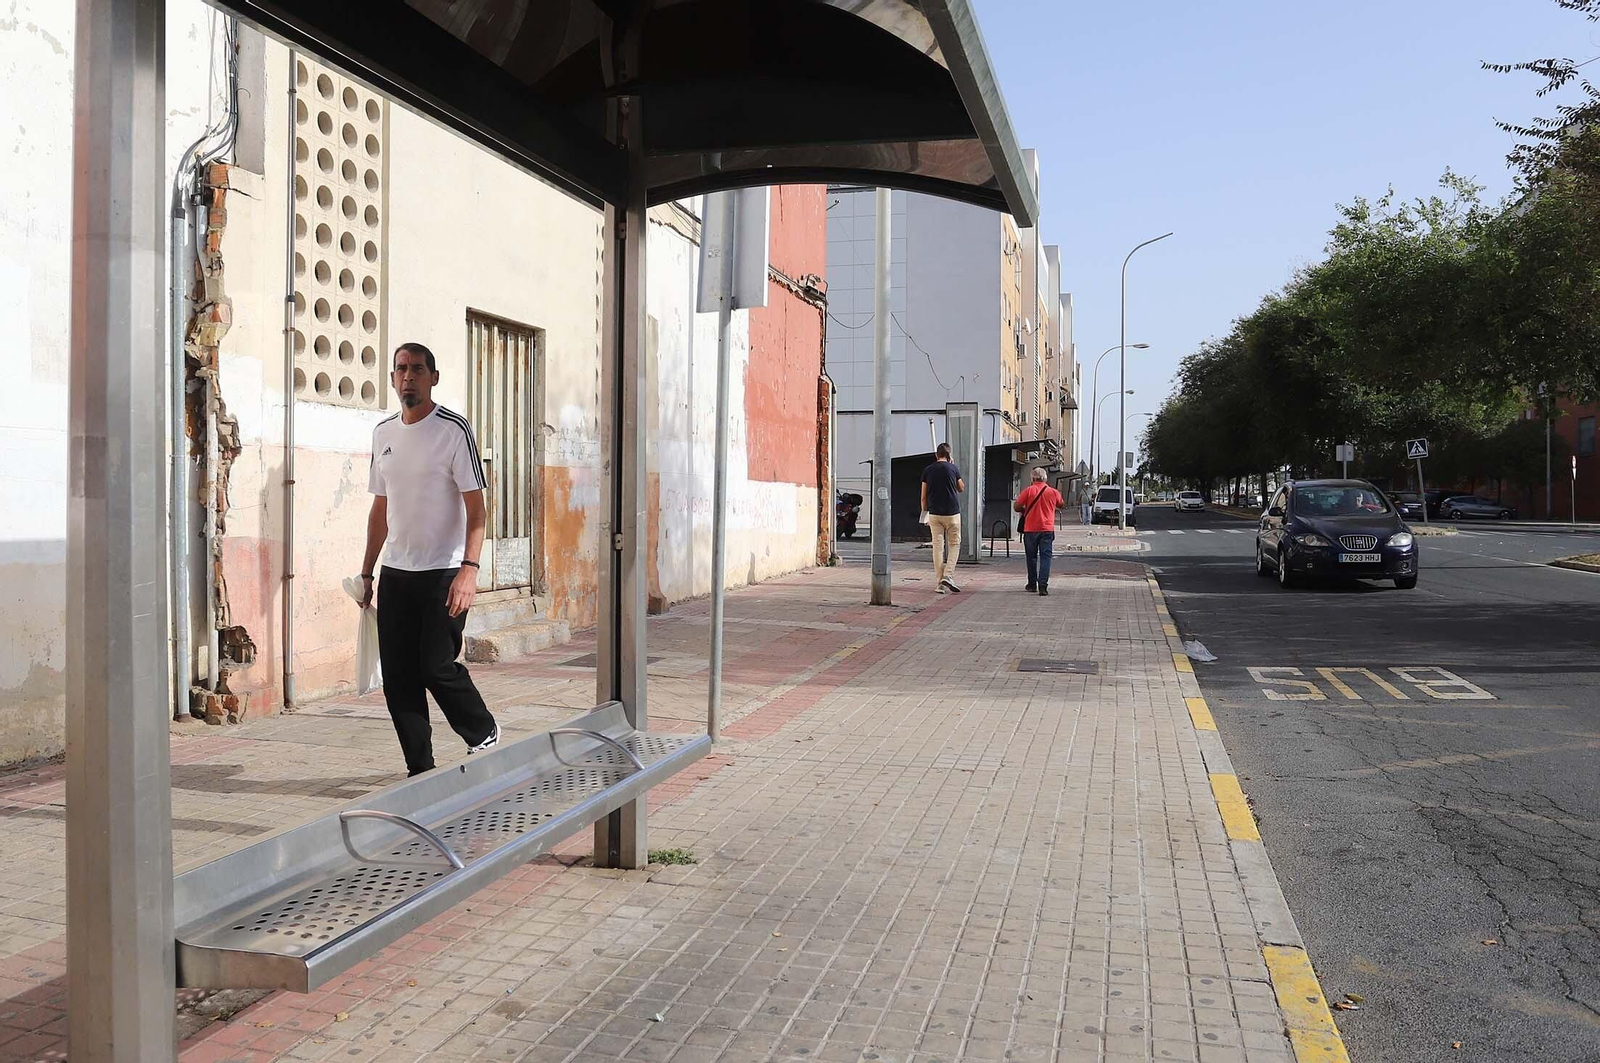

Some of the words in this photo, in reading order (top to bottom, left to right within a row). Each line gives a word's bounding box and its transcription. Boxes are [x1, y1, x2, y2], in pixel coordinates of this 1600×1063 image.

[1343, 554, 1363, 562] 7623
[1364, 554, 1380, 562] HHJ
[1246, 666, 1498, 701] BUS
